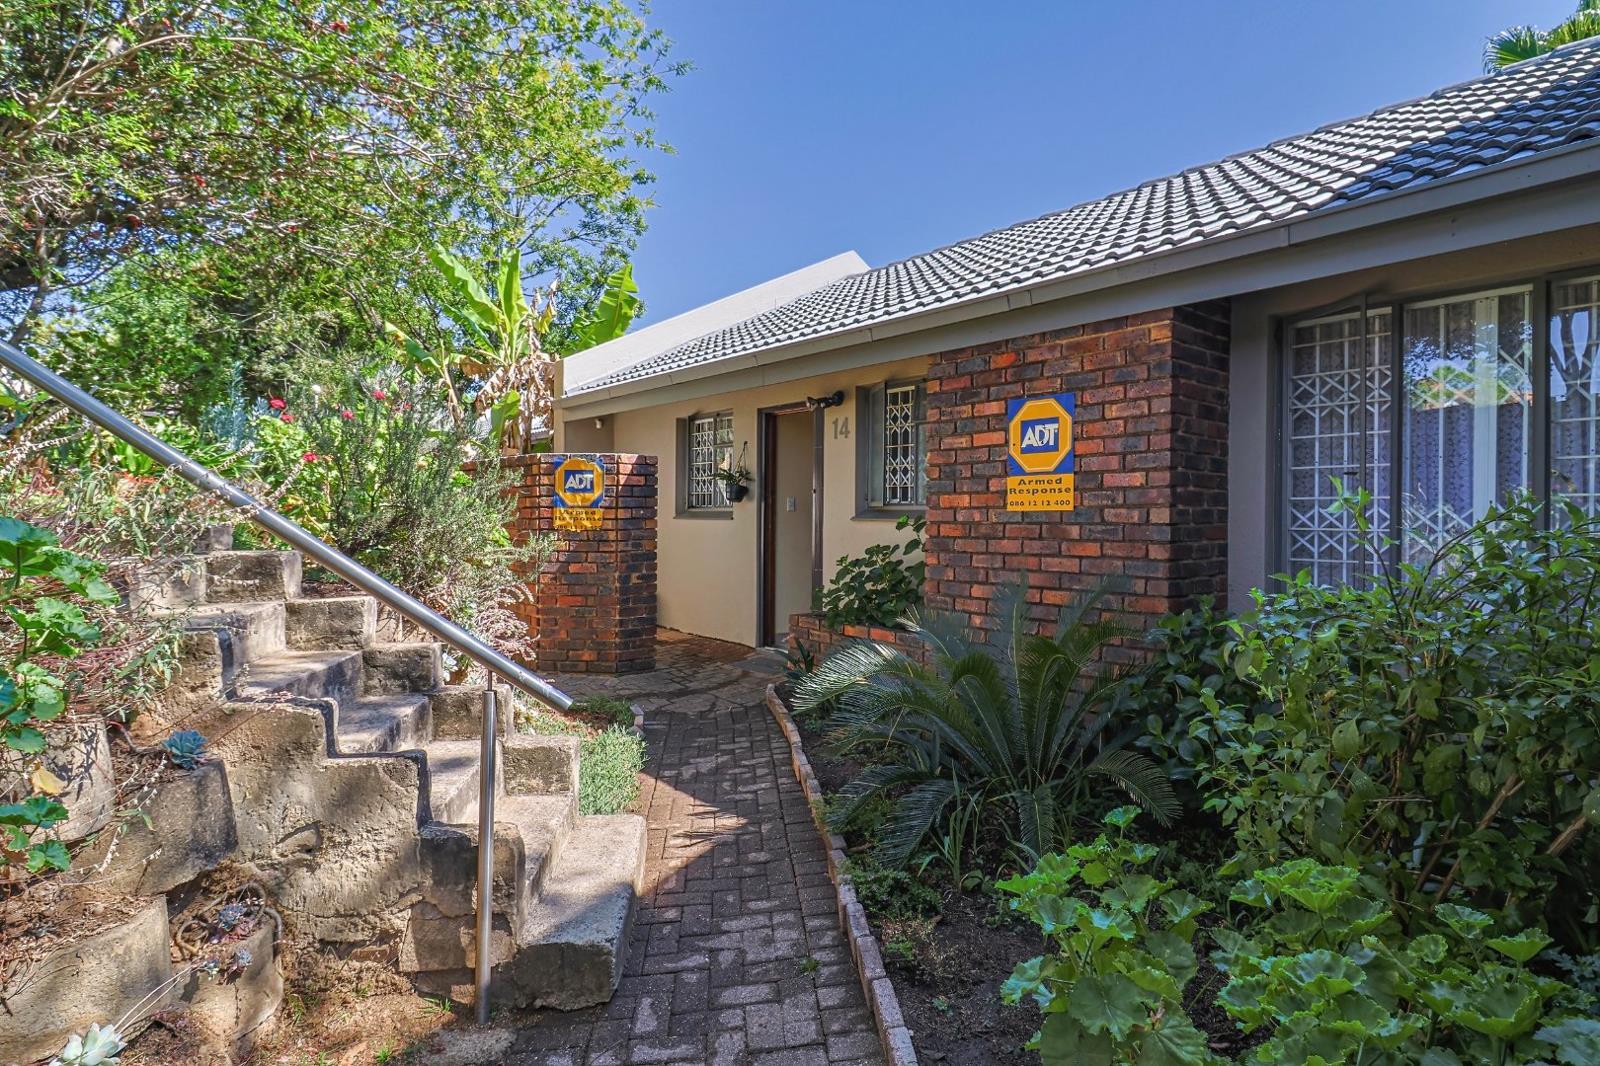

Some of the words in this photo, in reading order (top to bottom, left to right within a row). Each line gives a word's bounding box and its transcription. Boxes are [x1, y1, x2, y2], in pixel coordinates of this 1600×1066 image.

[832, 416, 850, 440] 14
[1021, 423, 1059, 448] ADT
[565, 473, 594, 489] ADT
[1018, 477, 1063, 486] Armed
[1009, 487, 1072, 496] Response
